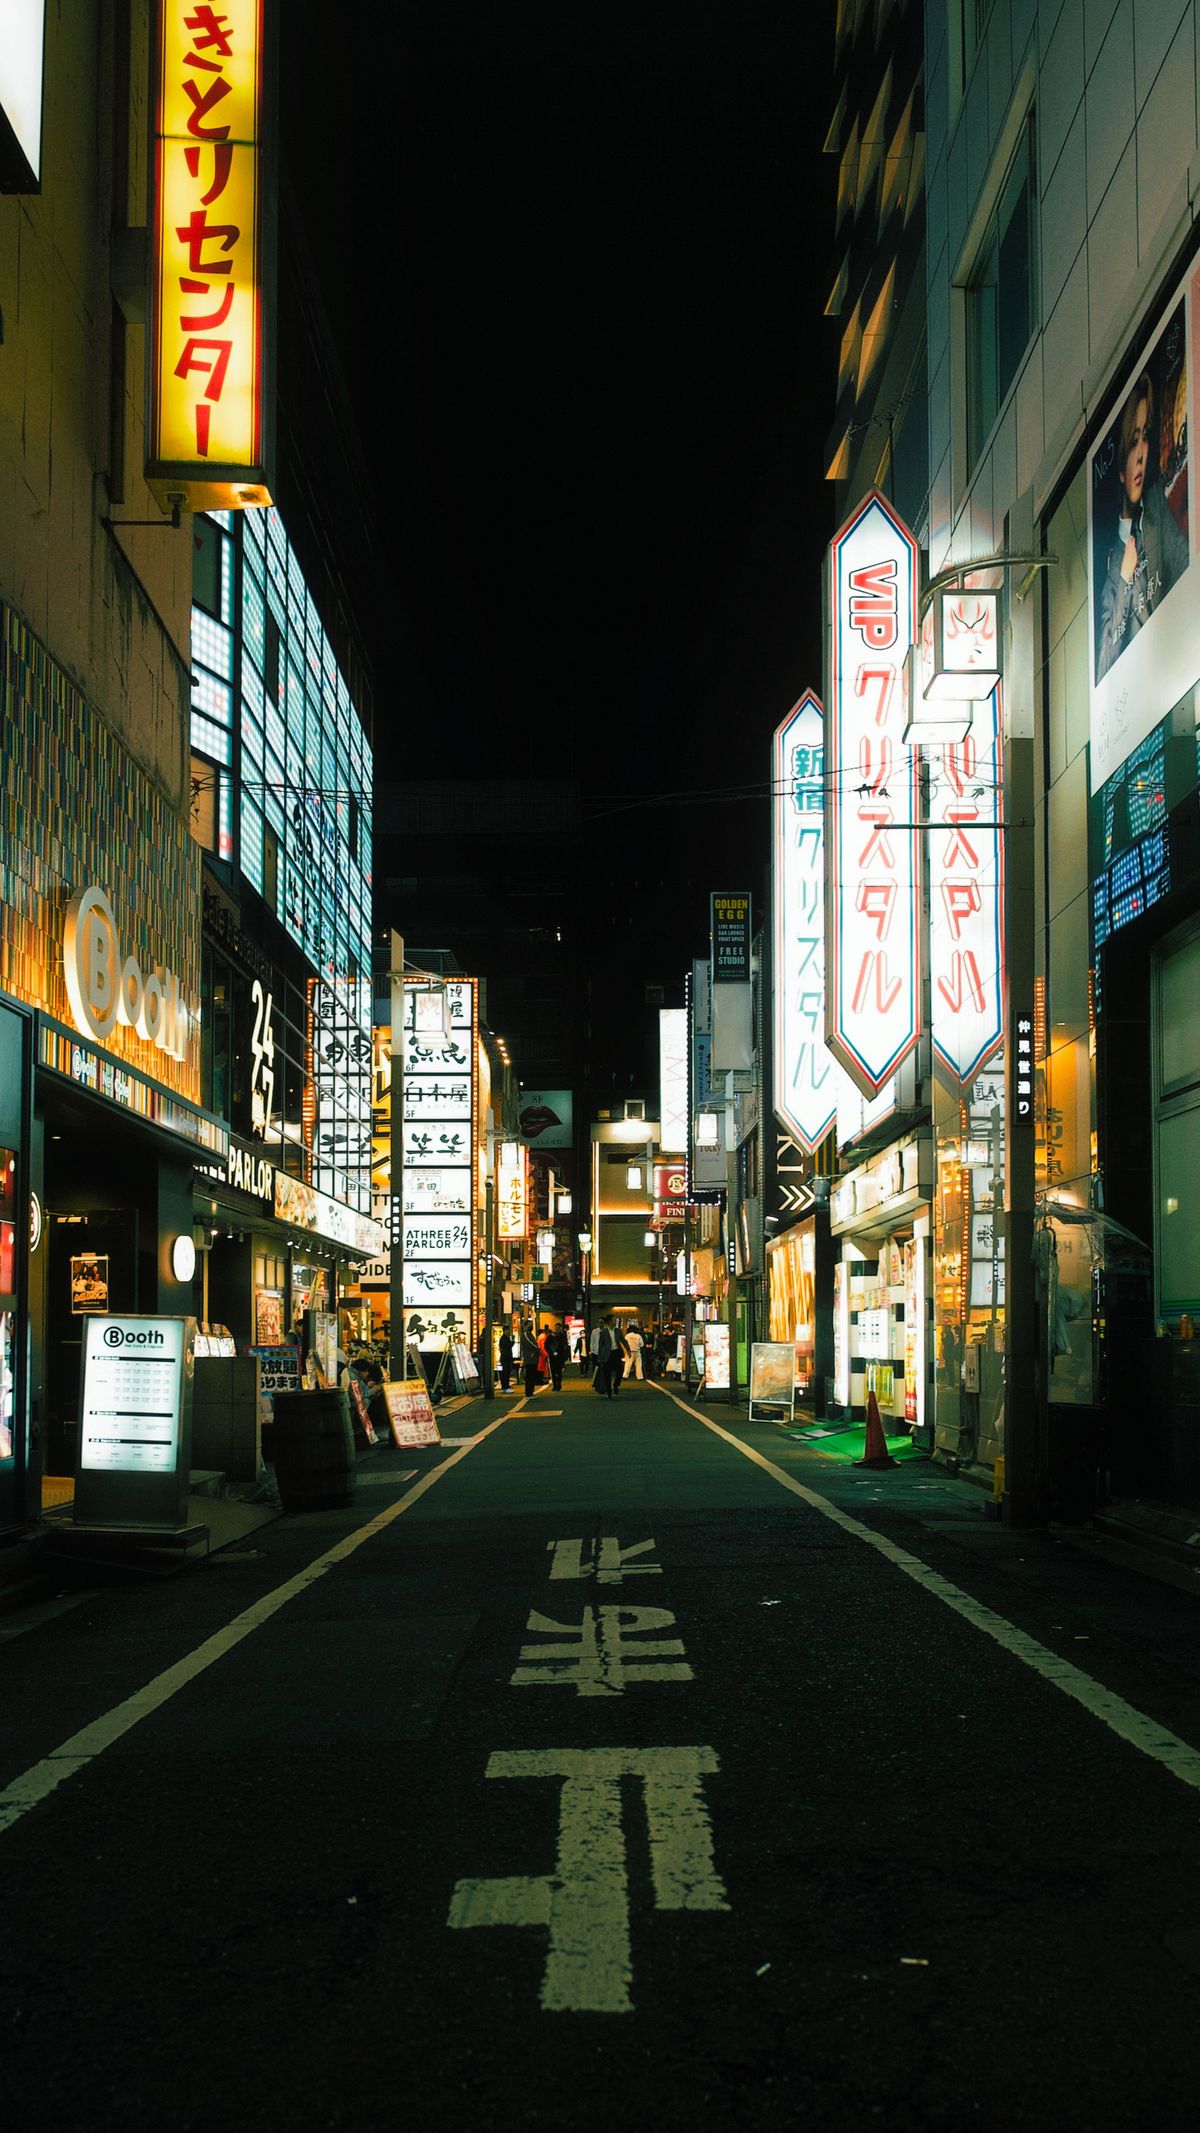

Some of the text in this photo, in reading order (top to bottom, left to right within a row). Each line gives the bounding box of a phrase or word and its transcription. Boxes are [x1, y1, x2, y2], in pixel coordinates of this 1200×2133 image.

[174, 0, 239, 457] きとりセンター
[714, 899, 748, 909] GOLDEN
[718, 910, 744, 920] EGG
[719, 947, 744, 955] FREE
[718, 956, 745, 965] STUDIO
[405, 1064, 416, 1072] 6F
[1018, 1020, 1031, 1114] 仲見世通り
[406, 1081, 469, 1102] 白木屋
[228, 1145, 272, 1200] PARLOR
[405, 1202, 415, 1210] 3F
[510, 1177, 521, 1226] ホルモン
[406, 1230, 451, 1239] ATHREE
[406, 1239, 451, 1249] PARLOR
[405, 1249, 415, 1257] 2F
[405, 1296, 415, 1304] 1F
[103, 1326, 164, 1348] Booth
